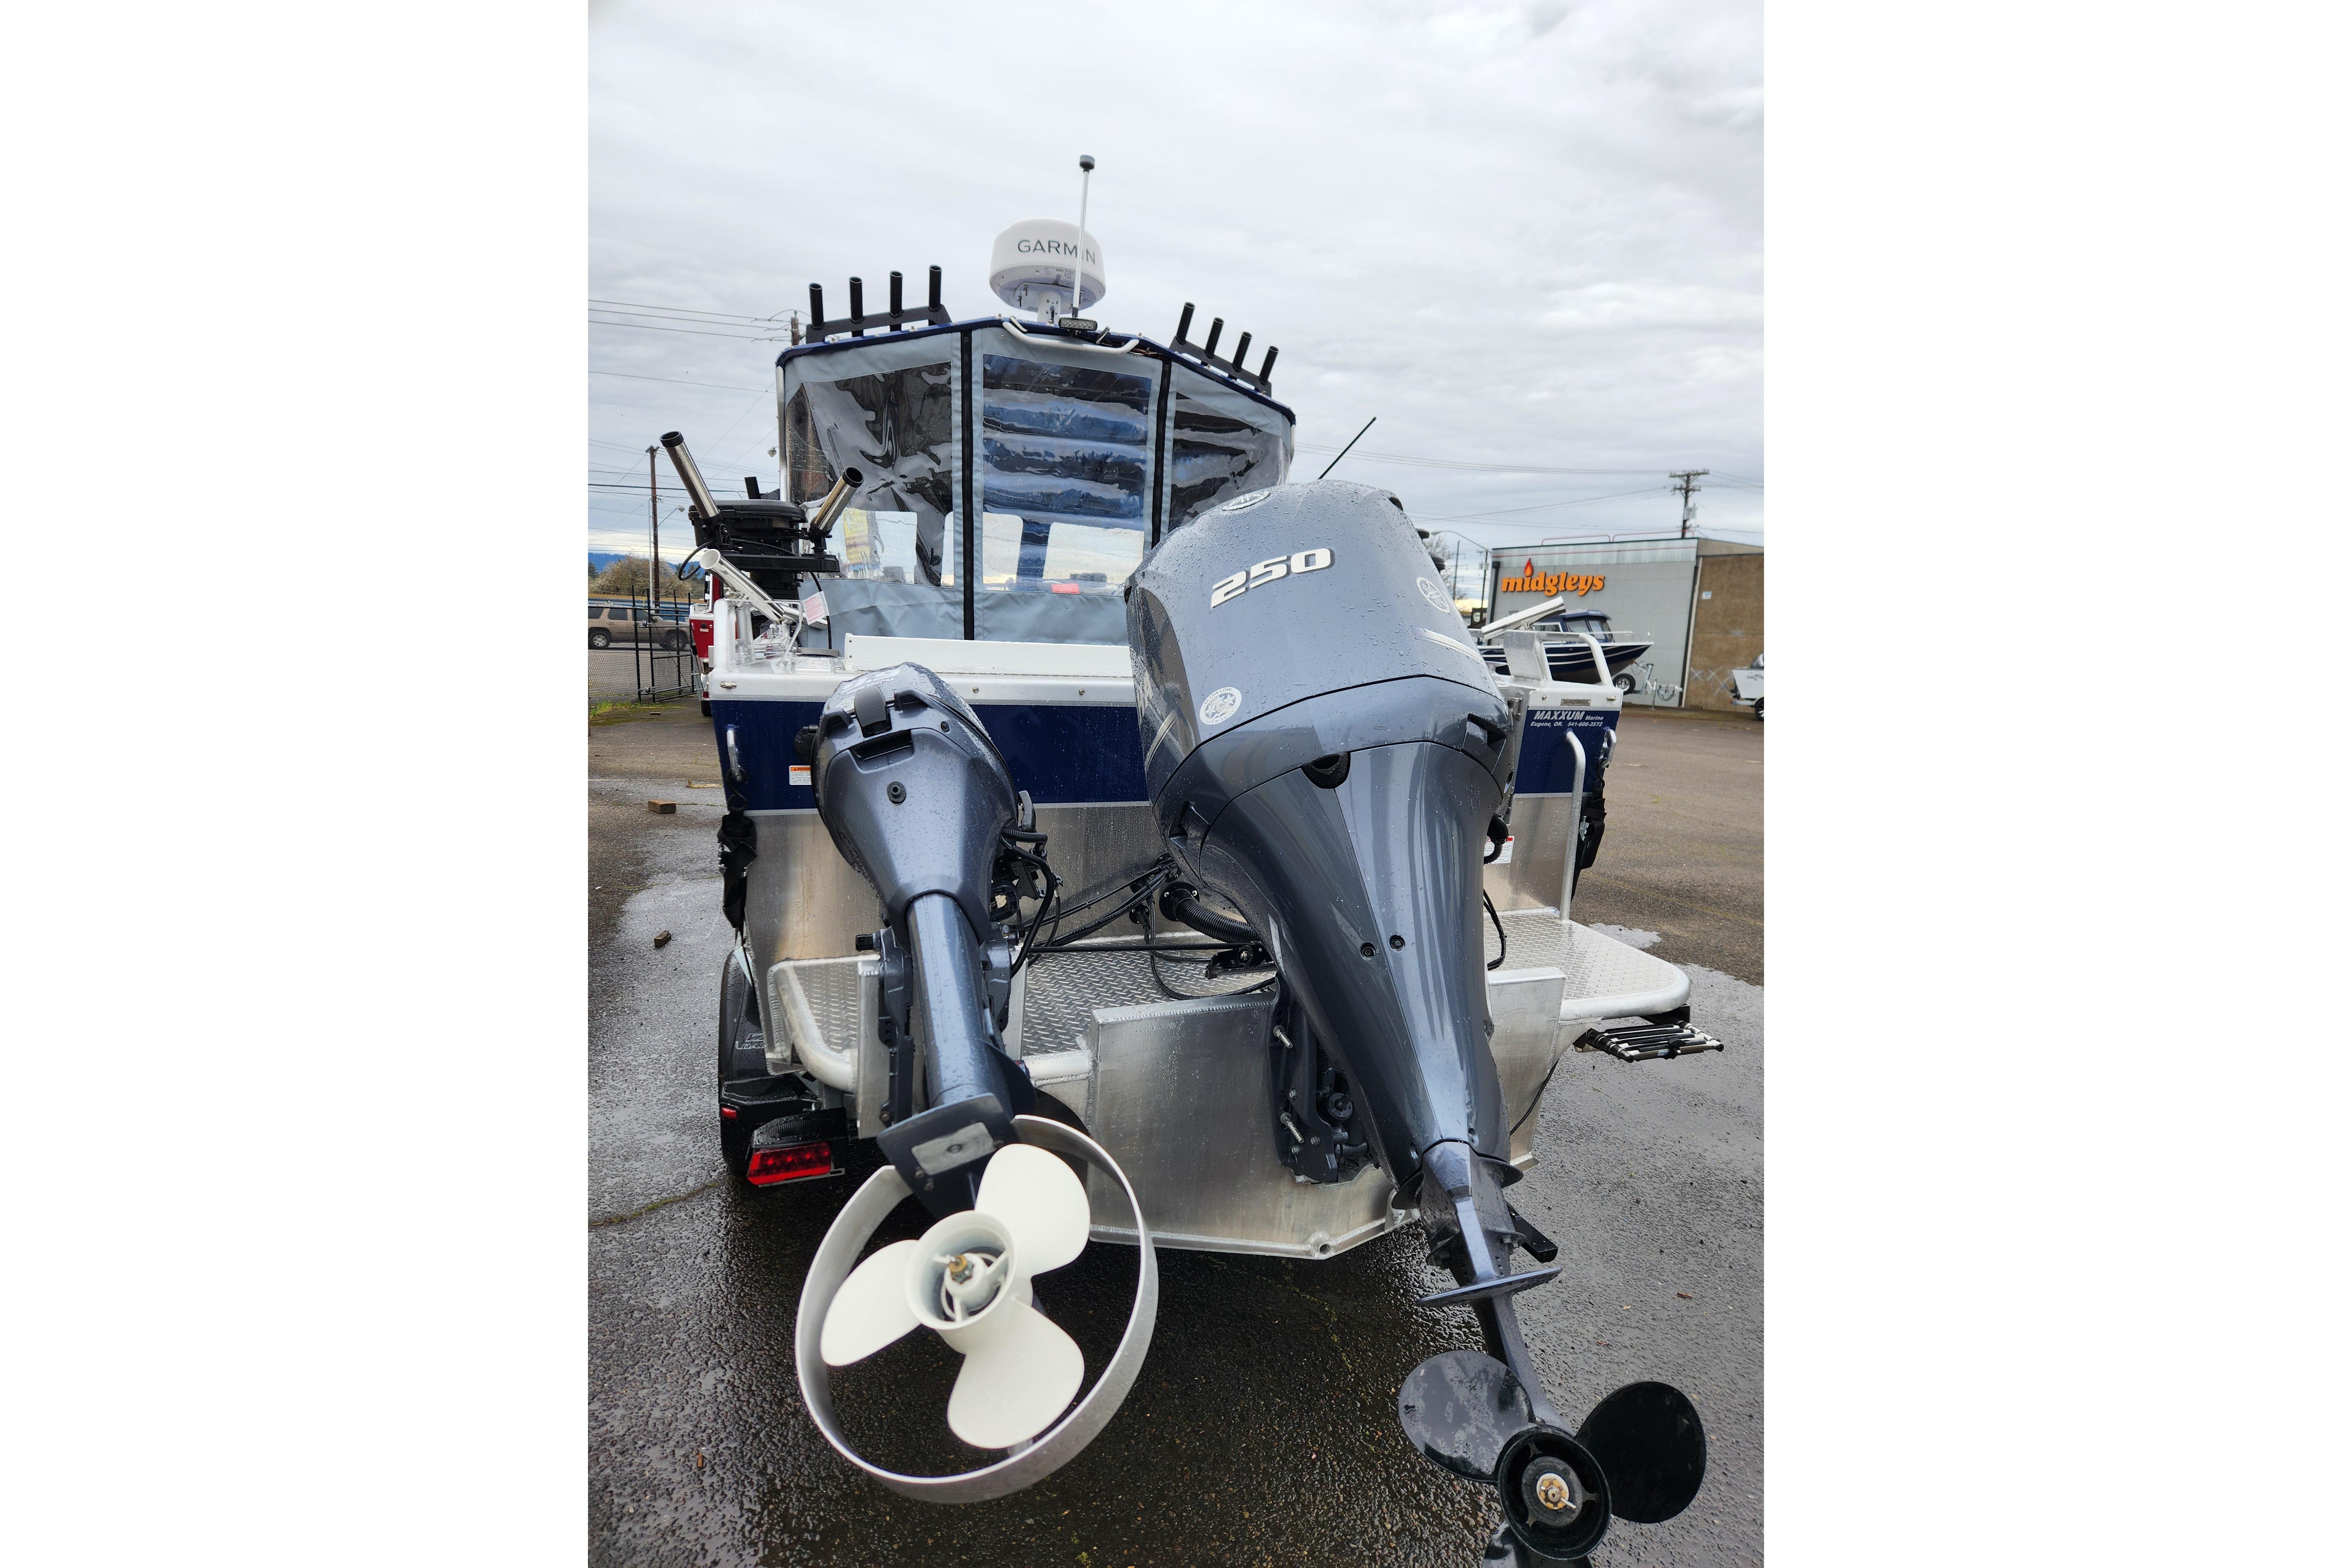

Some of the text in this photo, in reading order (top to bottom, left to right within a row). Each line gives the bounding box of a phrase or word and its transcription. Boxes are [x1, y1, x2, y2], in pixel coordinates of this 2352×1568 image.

[1018, 239, 1095, 265] GARMIN
[1211, 548, 1332, 608] 250
[1501, 572, 1605, 596] midgleys
[1534, 710, 1585, 720] MAXXUM
